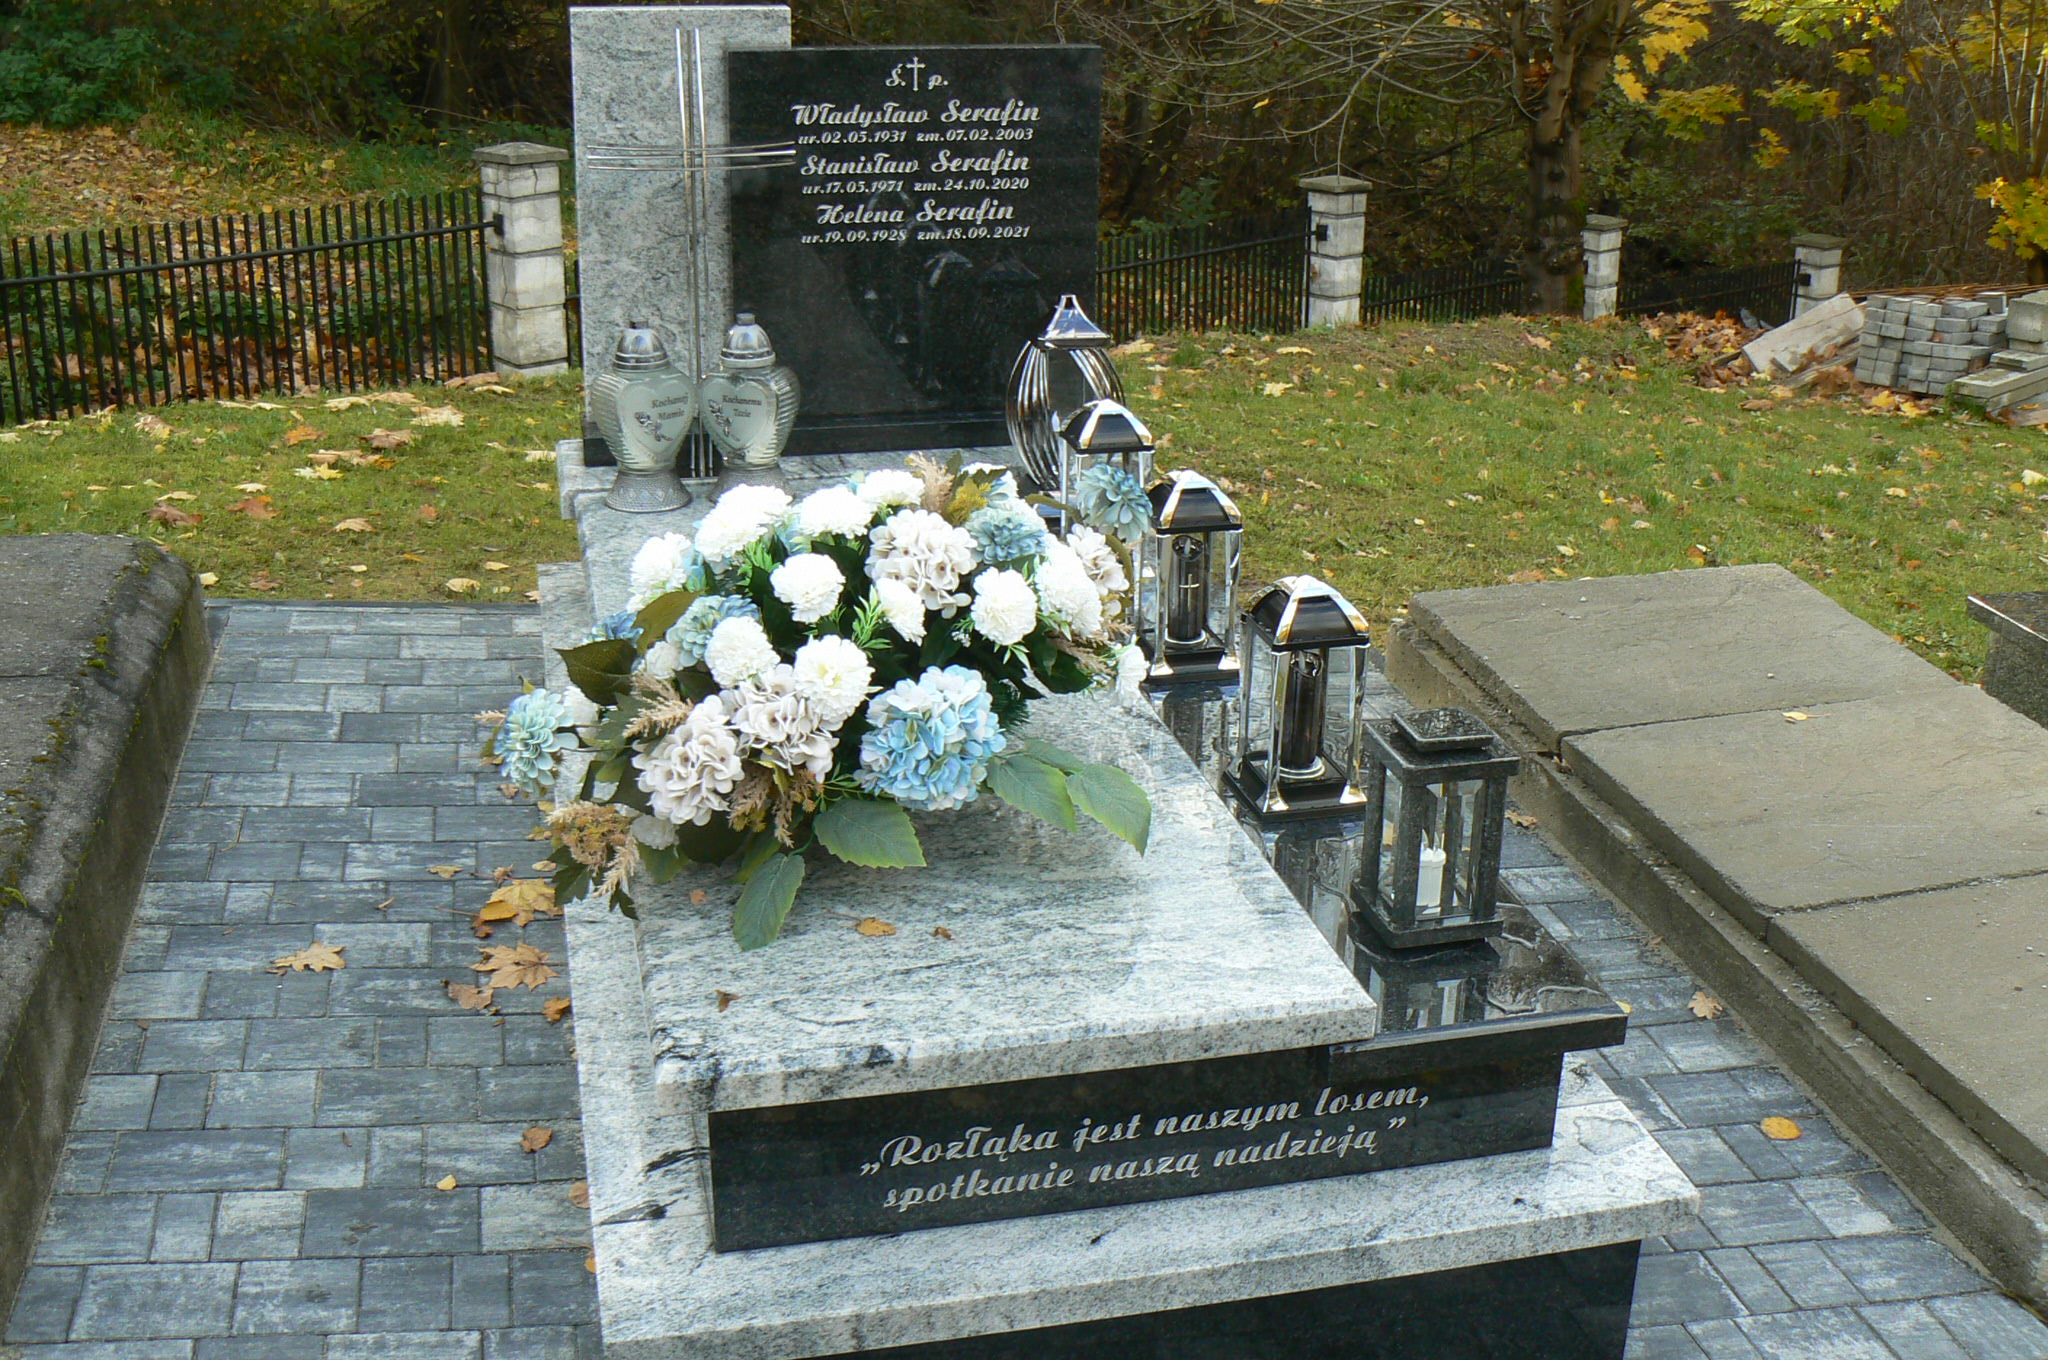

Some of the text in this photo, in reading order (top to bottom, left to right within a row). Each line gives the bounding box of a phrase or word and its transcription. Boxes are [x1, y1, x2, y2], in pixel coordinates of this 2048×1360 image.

[790, 98, 1040, 128] Władysław Serafin
[798, 128, 1034, 145] ur.02.05.1931 zm.07.02.2003
[800, 149, 1030, 176] Stanisław Serafin
[802, 177, 1030, 195] ur.17.05.1971 zm.24.10.2020
[816, 199, 1015, 226] Helena Serafin
[801, 226, 1031, 244] ur.19.09.1928 zm.18.09.2021
[1071, 1113, 1142, 1154] jest
[1154, 1098, 1302, 1137] naszym
[1314, 1085, 1431, 1118] losem,
[883, 1160, 1077, 1212] spotkanie
[1088, 1148, 1201, 1183] naszą
